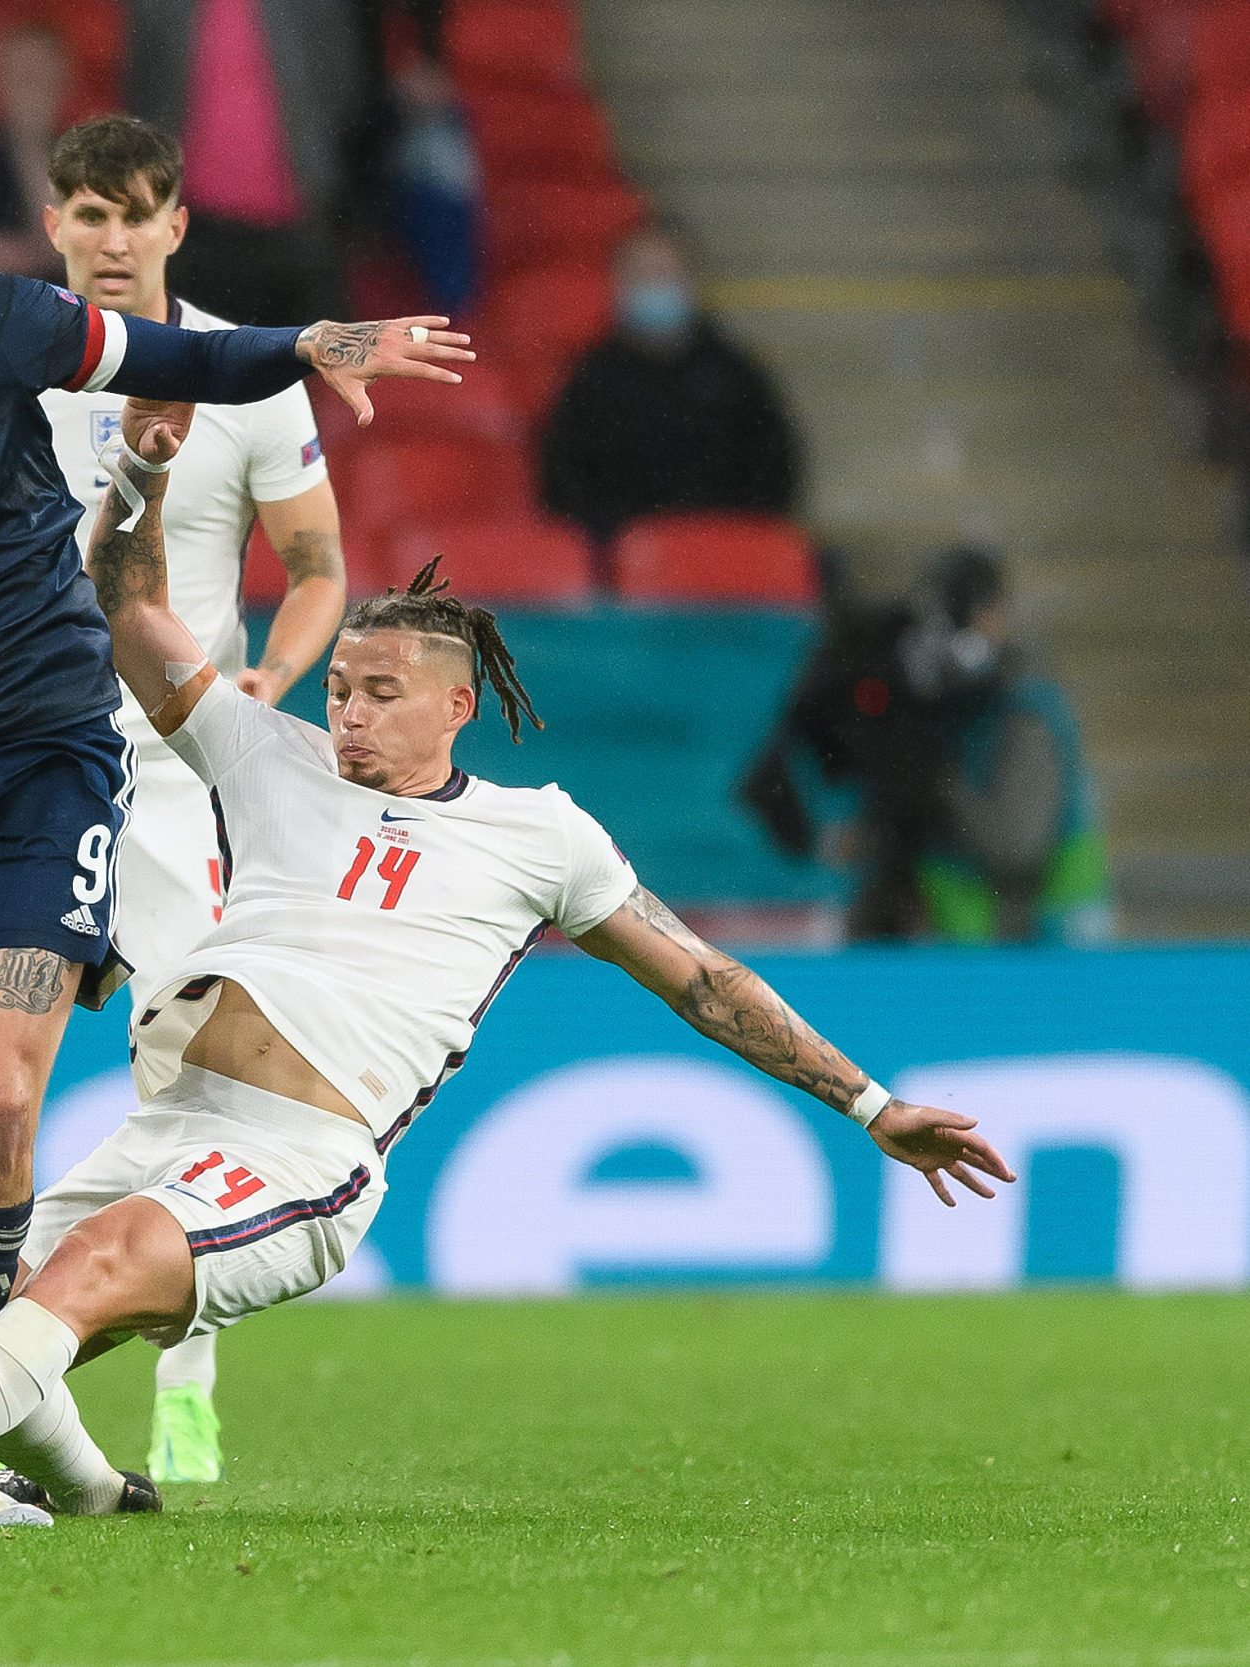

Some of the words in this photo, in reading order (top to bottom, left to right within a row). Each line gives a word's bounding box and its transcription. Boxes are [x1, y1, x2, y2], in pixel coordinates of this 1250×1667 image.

[72, 824, 112, 905] 9
[336, 835, 422, 910] 14
[60, 915, 101, 937] adidas
[178, 1150, 268, 1211] 14
